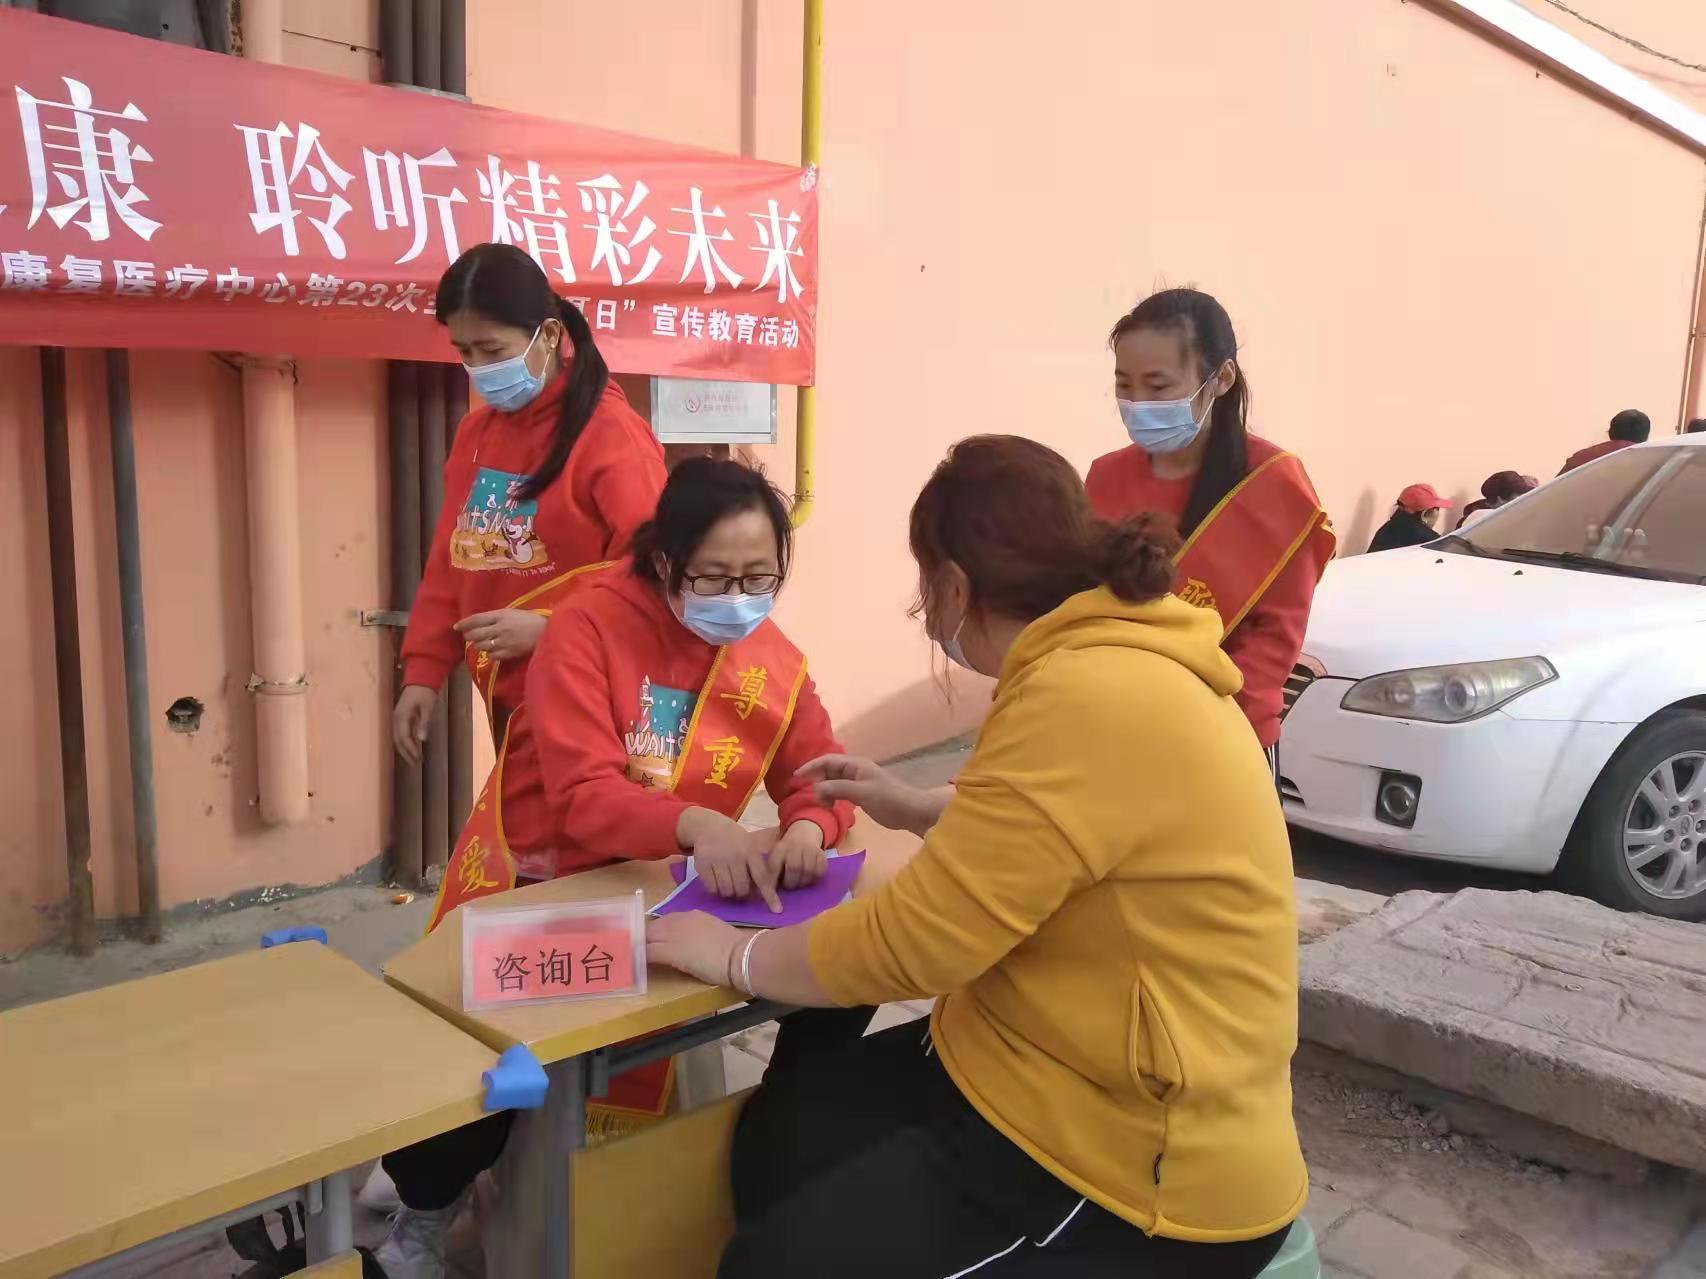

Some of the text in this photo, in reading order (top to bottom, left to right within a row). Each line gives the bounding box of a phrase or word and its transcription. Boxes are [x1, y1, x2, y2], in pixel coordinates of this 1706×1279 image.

[0, 76, 804, 303] 康 聆听精彩未来
[0, 250, 437, 315] 康复医疗中心第23次
[492, 944, 614, 993] 咨询台
